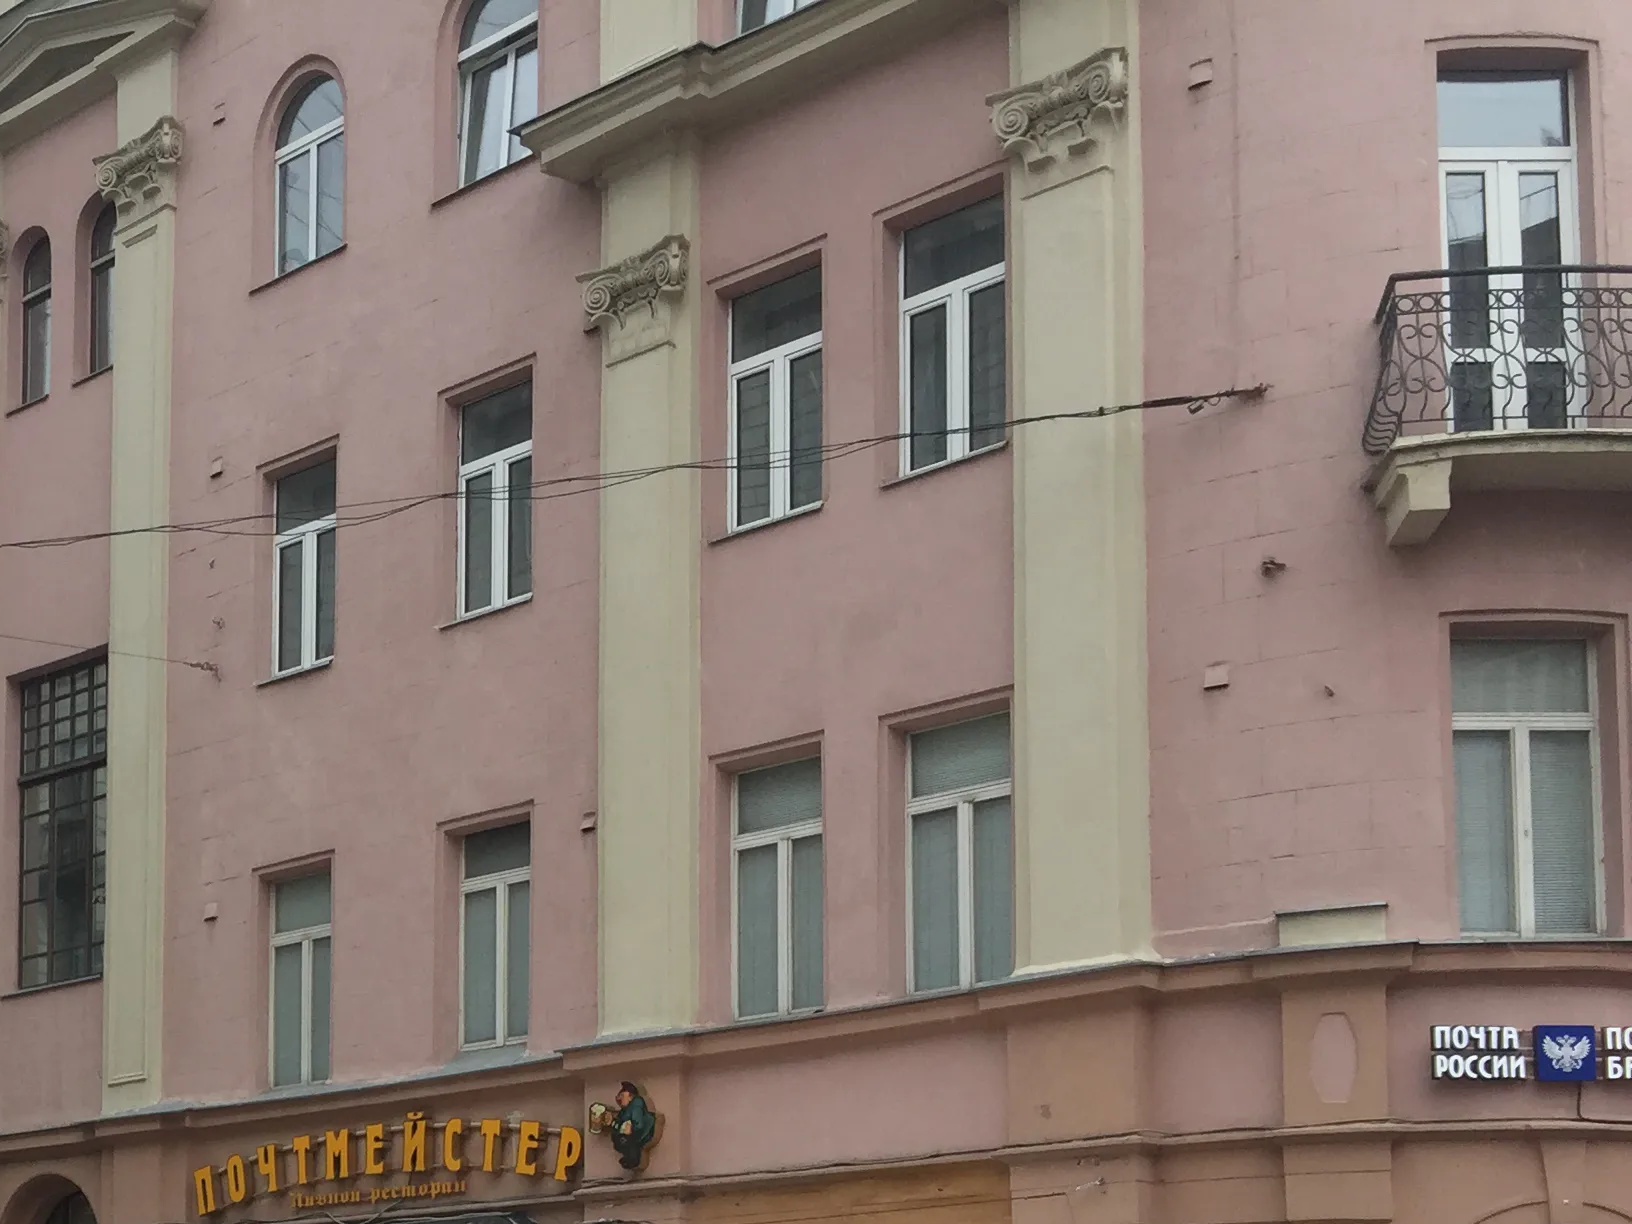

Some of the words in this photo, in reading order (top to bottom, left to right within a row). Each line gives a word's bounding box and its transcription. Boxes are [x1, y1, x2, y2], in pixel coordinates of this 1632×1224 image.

[1433, 1026, 1520, 1050] ПОЧТА
[1434, 1054, 1526, 1079] РОССИИ
[194, 1112, 582, 1216] ПОЧТМЕЙСТЕР
